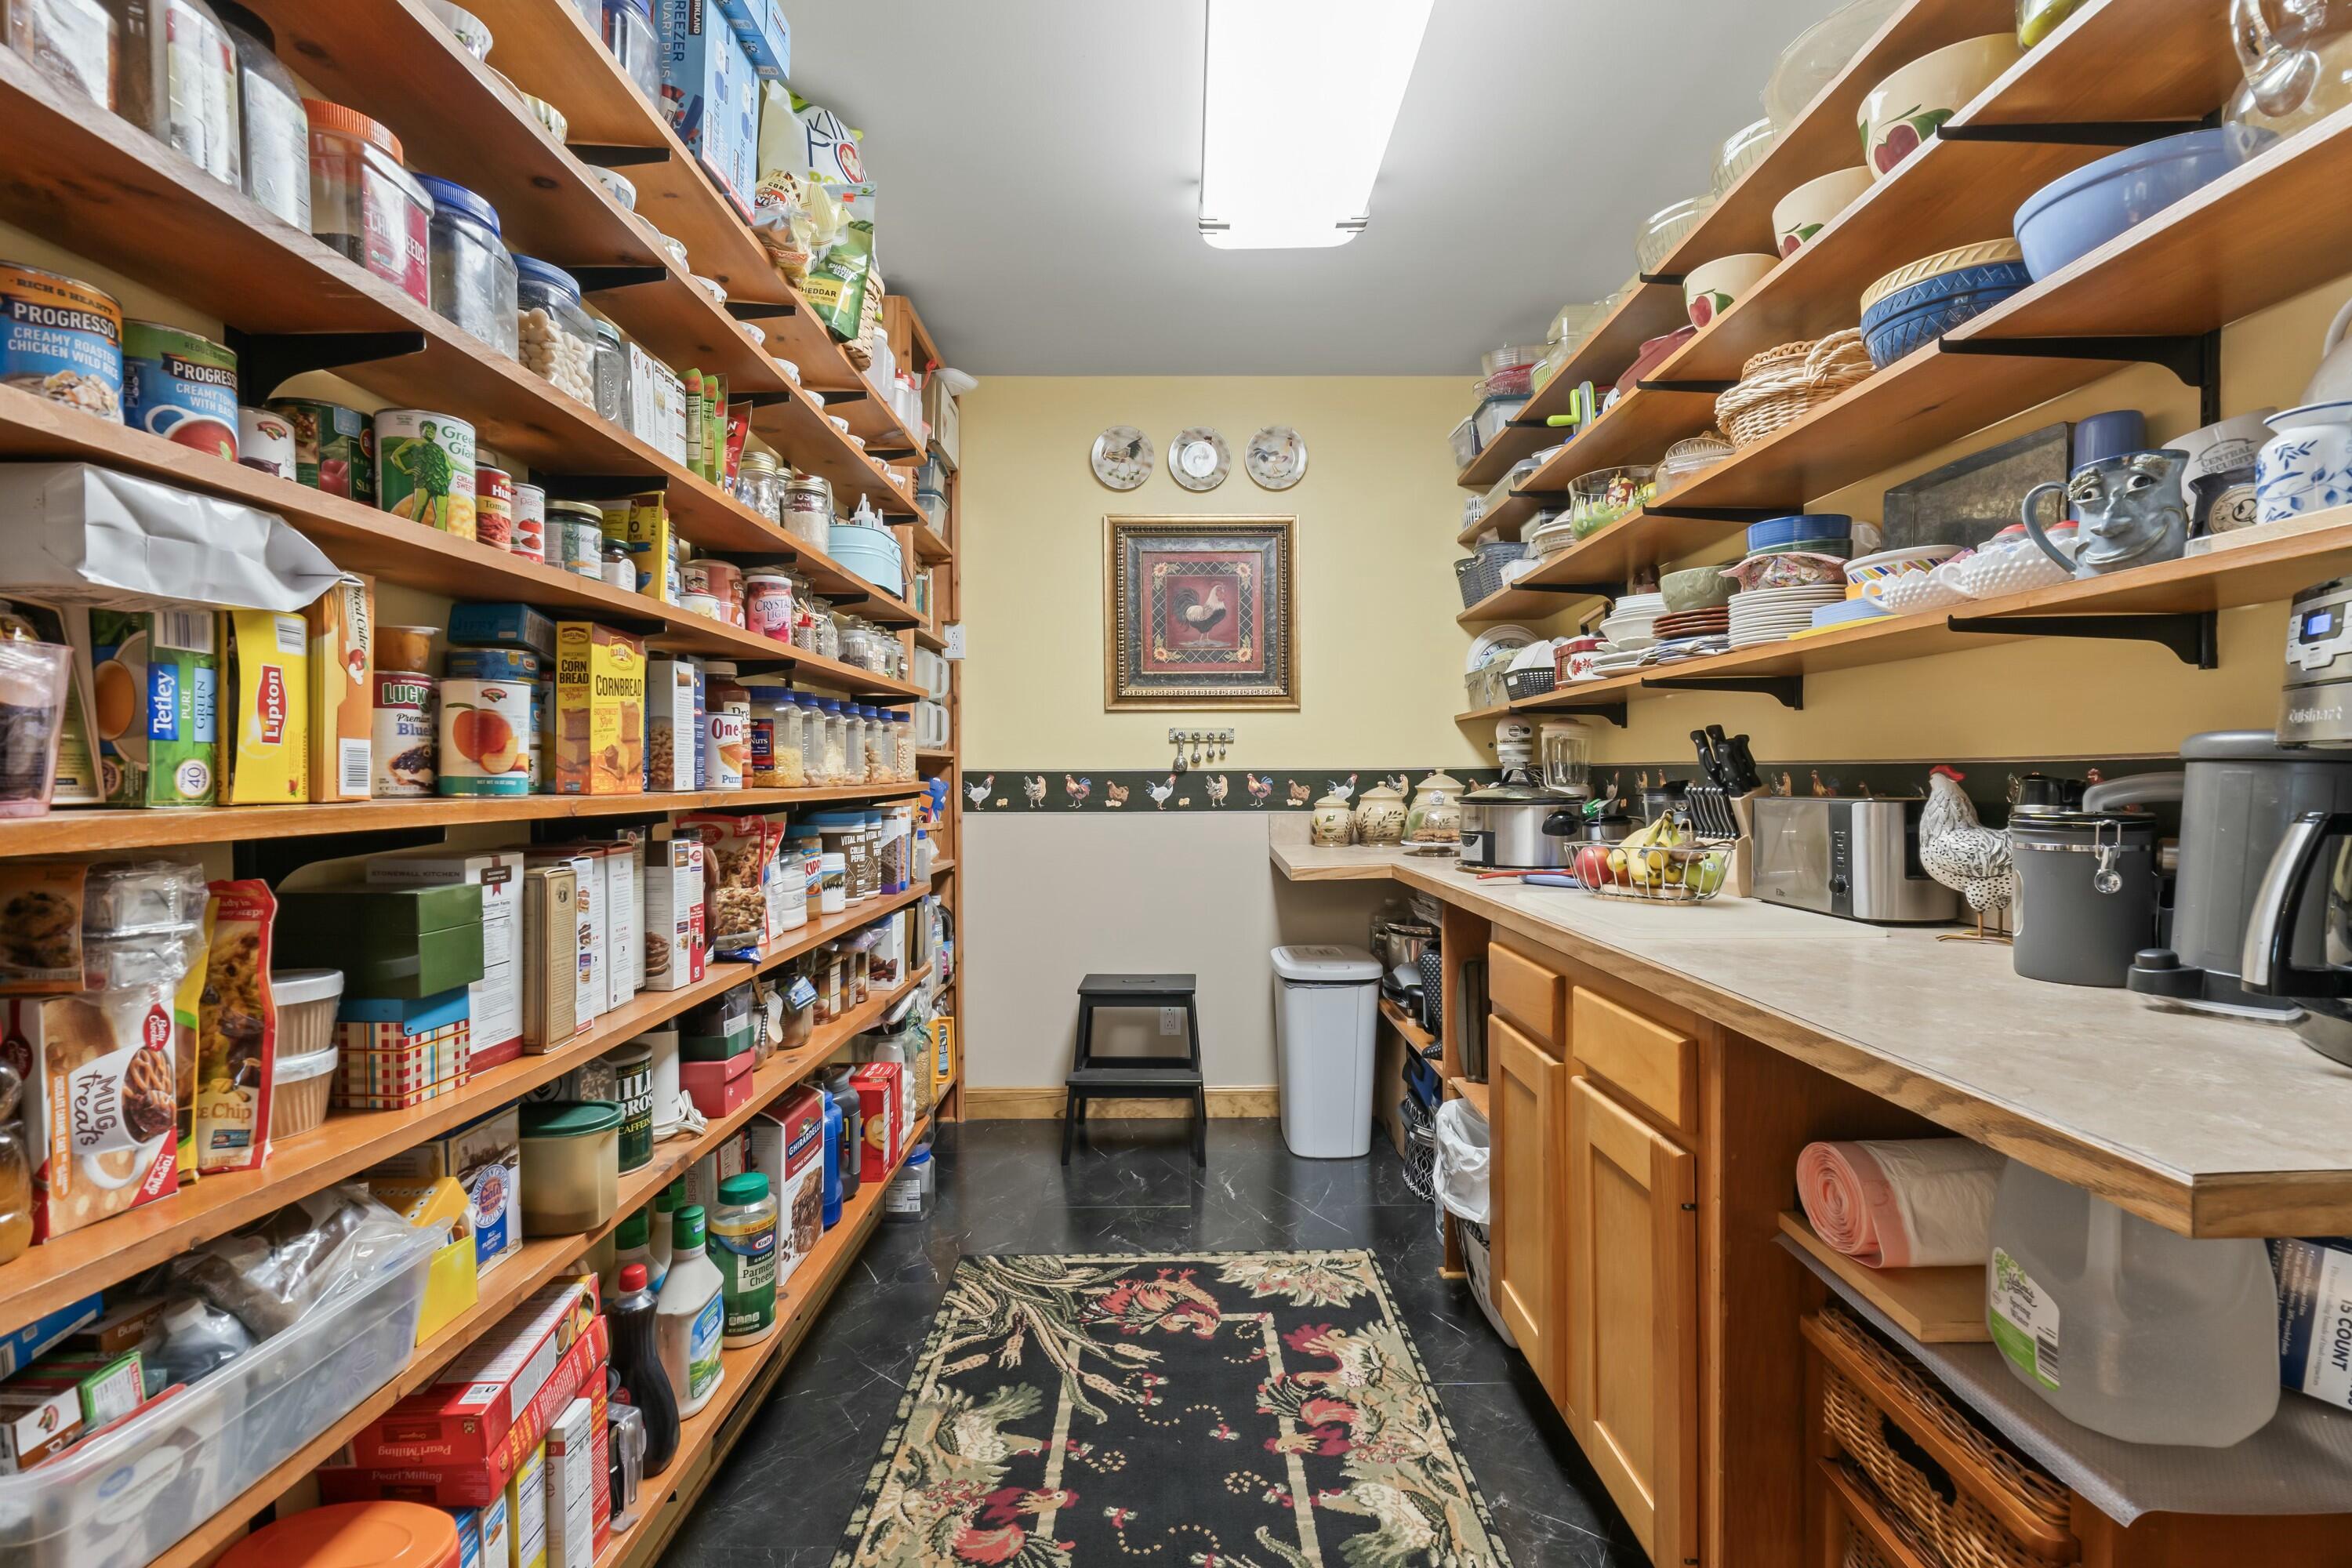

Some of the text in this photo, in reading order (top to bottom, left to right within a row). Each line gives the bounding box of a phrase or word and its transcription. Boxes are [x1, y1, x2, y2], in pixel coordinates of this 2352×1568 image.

[662, 0, 673, 38] UART
[693, 0, 702, 34] IRKLAND
[673, 0, 686, 62] REEZER
[768, 182, 789, 194] CORN
[406, 236, 426, 267] EEDS
[828, 263, 858, 281] SHARING
[17, 278, 114, 315] RICH & HEARTY
[14, 302, 115, 339] PROGRESSO
[13, 327, 116, 366] CREAMY ROASTED
[8, 338, 119, 381] CHICKEN WILD RICE
[173, 361, 238, 389] PROGRESS
[176, 383, 216, 400] CREAMY
[191, 396, 234, 415] WITH BAS
[448, 442, 475, 461] Gian
[2201, 445, 2254, 467] CENTRAL
[2201, 454, 2256, 474] SECURITY
[456, 481, 474, 492] SWEE
[492, 485, 512, 500] Hun
[485, 500, 511, 513] Tomat
[357, 619, 368, 652] Cider
[561, 659, 587, 672] CORN
[560, 673, 590, 684] BREAD
[596, 675, 642, 697] CORNBREAD
[153, 670, 176, 733] Tetley
[181, 688, 192, 719] PURE
[197, 681, 205, 729] GREEN
[206, 692, 215, 717] TEA
[264, 671, 284, 739] Lipton
[187, 767, 201, 788] 40
[841, 835, 856, 846] VITAL
[866, 831, 877, 841] VITAL
[850, 846, 865, 855] COLLA
[805, 859, 822, 877] KIPP
[74, 1069, 104, 1146] treats
[93, 1075, 118, 1131] MUG
[211, 1102, 252, 1126] Chip
[789, 1120, 822, 1156] GHIRARDELLI
[793, 1143, 819, 1172] TRIPLE CHOCOLATE
[150, 1153, 175, 1196] TOPPING
[687, 1165, 699, 1203] lasagn
[480, 1182, 503, 1204] Gold
[479, 1205, 503, 1224] FLOUR
[757, 1237, 771, 1247] Kraft
[753, 1250, 773, 1263] GRATED
[742, 1259, 775, 1279] Parmesa
[2009, 1296, 2031, 1319] Spring
[2332, 1318, 2352, 1372] COUNT
[592, 1393, 608, 1417] ACK
[378, 1444, 452, 1457] Pearl Milling
[372, 1471, 442, 1483] Pearl Milling
